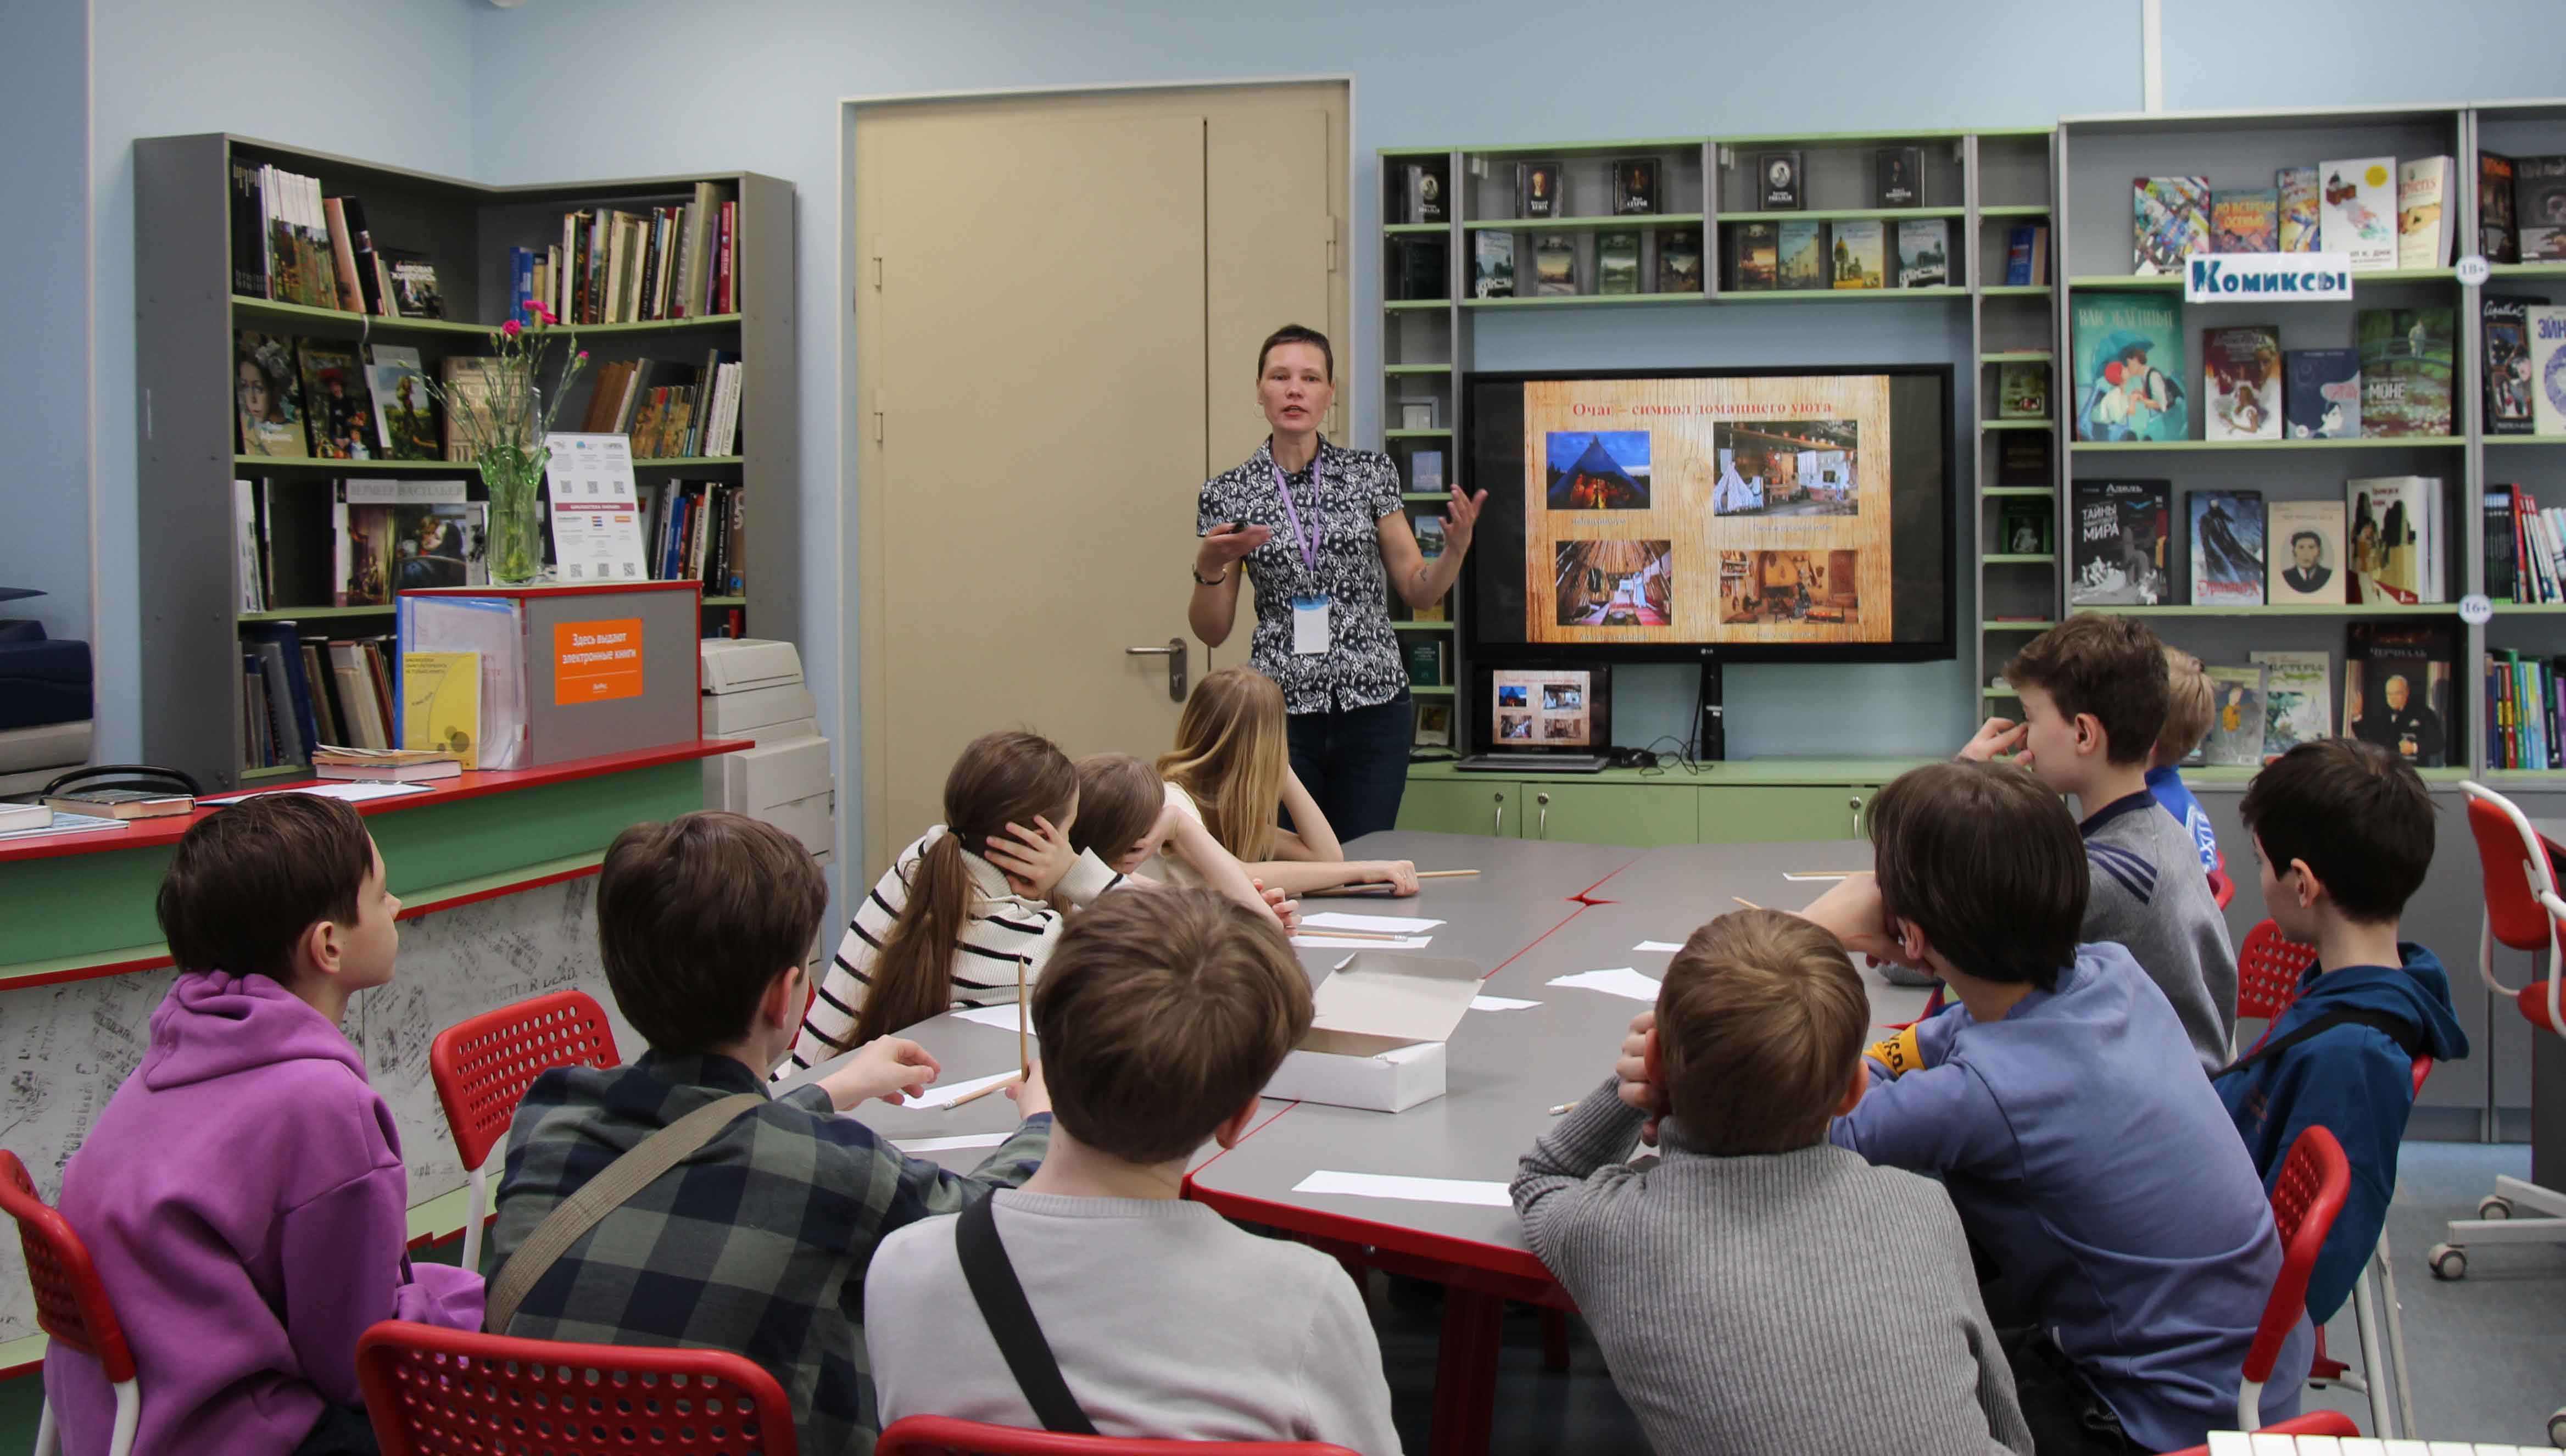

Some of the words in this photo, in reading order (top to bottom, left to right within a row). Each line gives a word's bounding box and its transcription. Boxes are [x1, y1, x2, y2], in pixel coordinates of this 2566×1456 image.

[2192, 260, 2347, 292] Комиксы
[2462, 264, 2484, 275] 18+
[2369, 383, 2406, 399] МОНЕ
[1573, 403, 1614, 417] Очаг
[1632, 404, 1691, 415] символ
[1695, 402, 1786, 416] домашнего
[1791, 401, 1832, 417] уюта
[2082, 503, 2117, 520] ТАЙНЫ
[2083, 522, 2120, 543] МИРА
[2465, 602, 2487, 613] 16+
[572, 633, 596, 647] Здесь
[596, 633, 627, 644] выдают
[562, 650, 613, 665] электронные
[614, 649, 637, 659] книги
